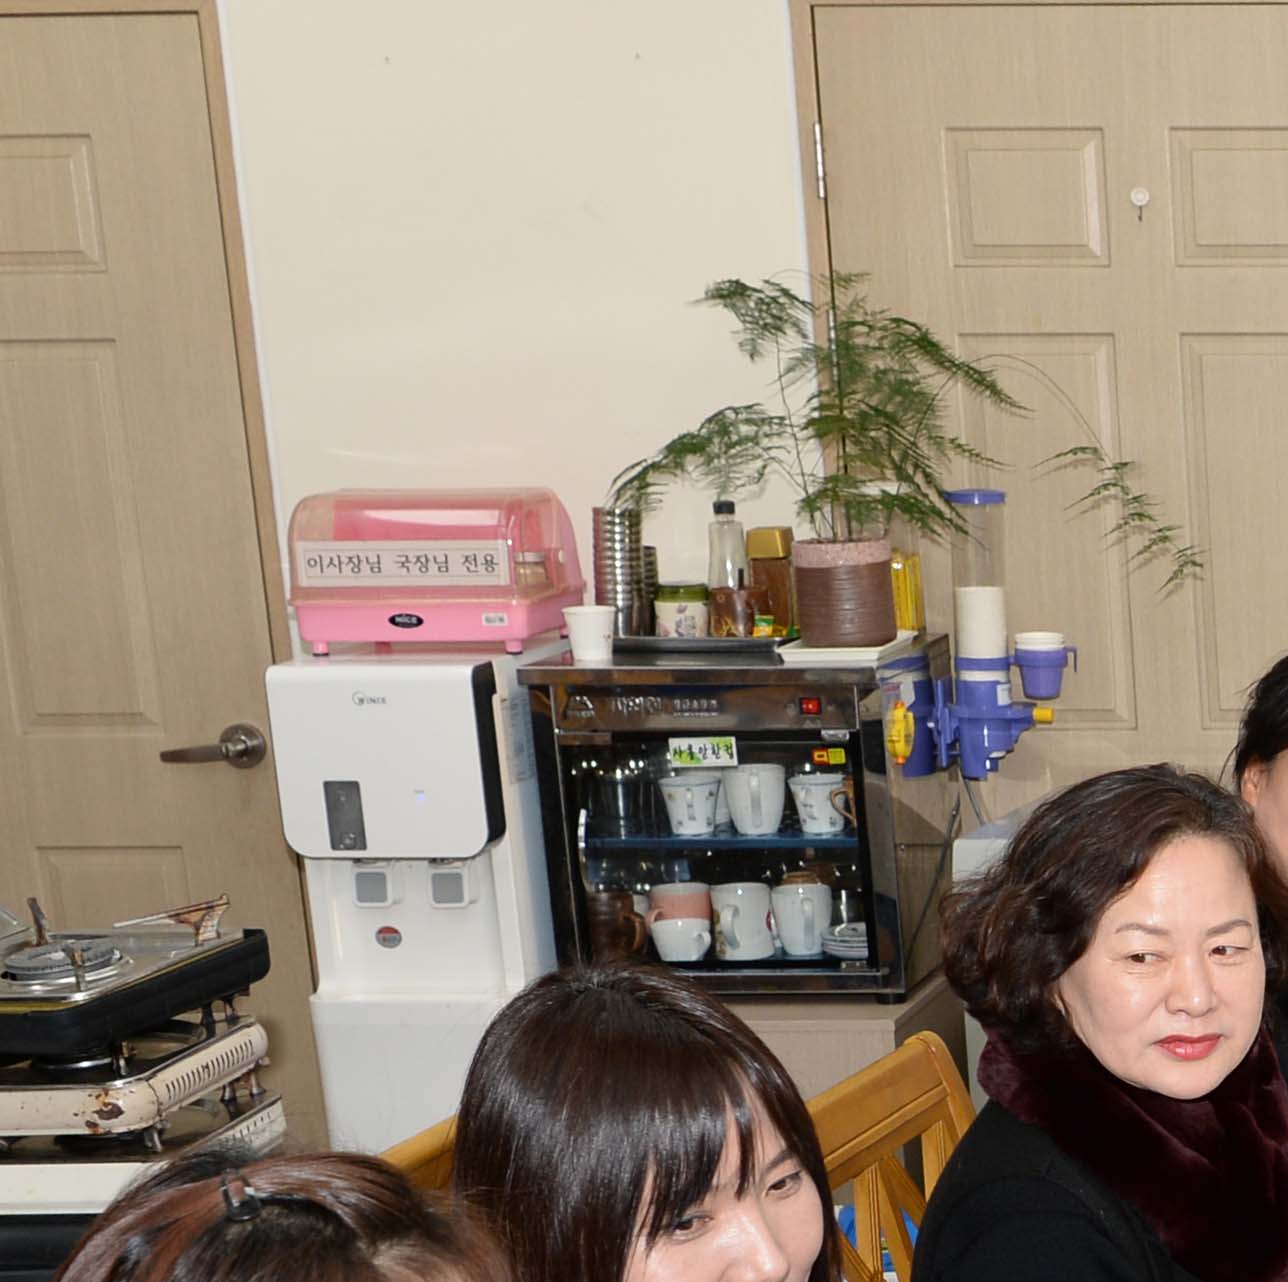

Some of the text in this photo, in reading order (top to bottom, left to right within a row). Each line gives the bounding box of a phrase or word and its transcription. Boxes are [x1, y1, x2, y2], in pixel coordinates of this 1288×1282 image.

[307, 553, 500, 574] 이사장님 국장님 전용
